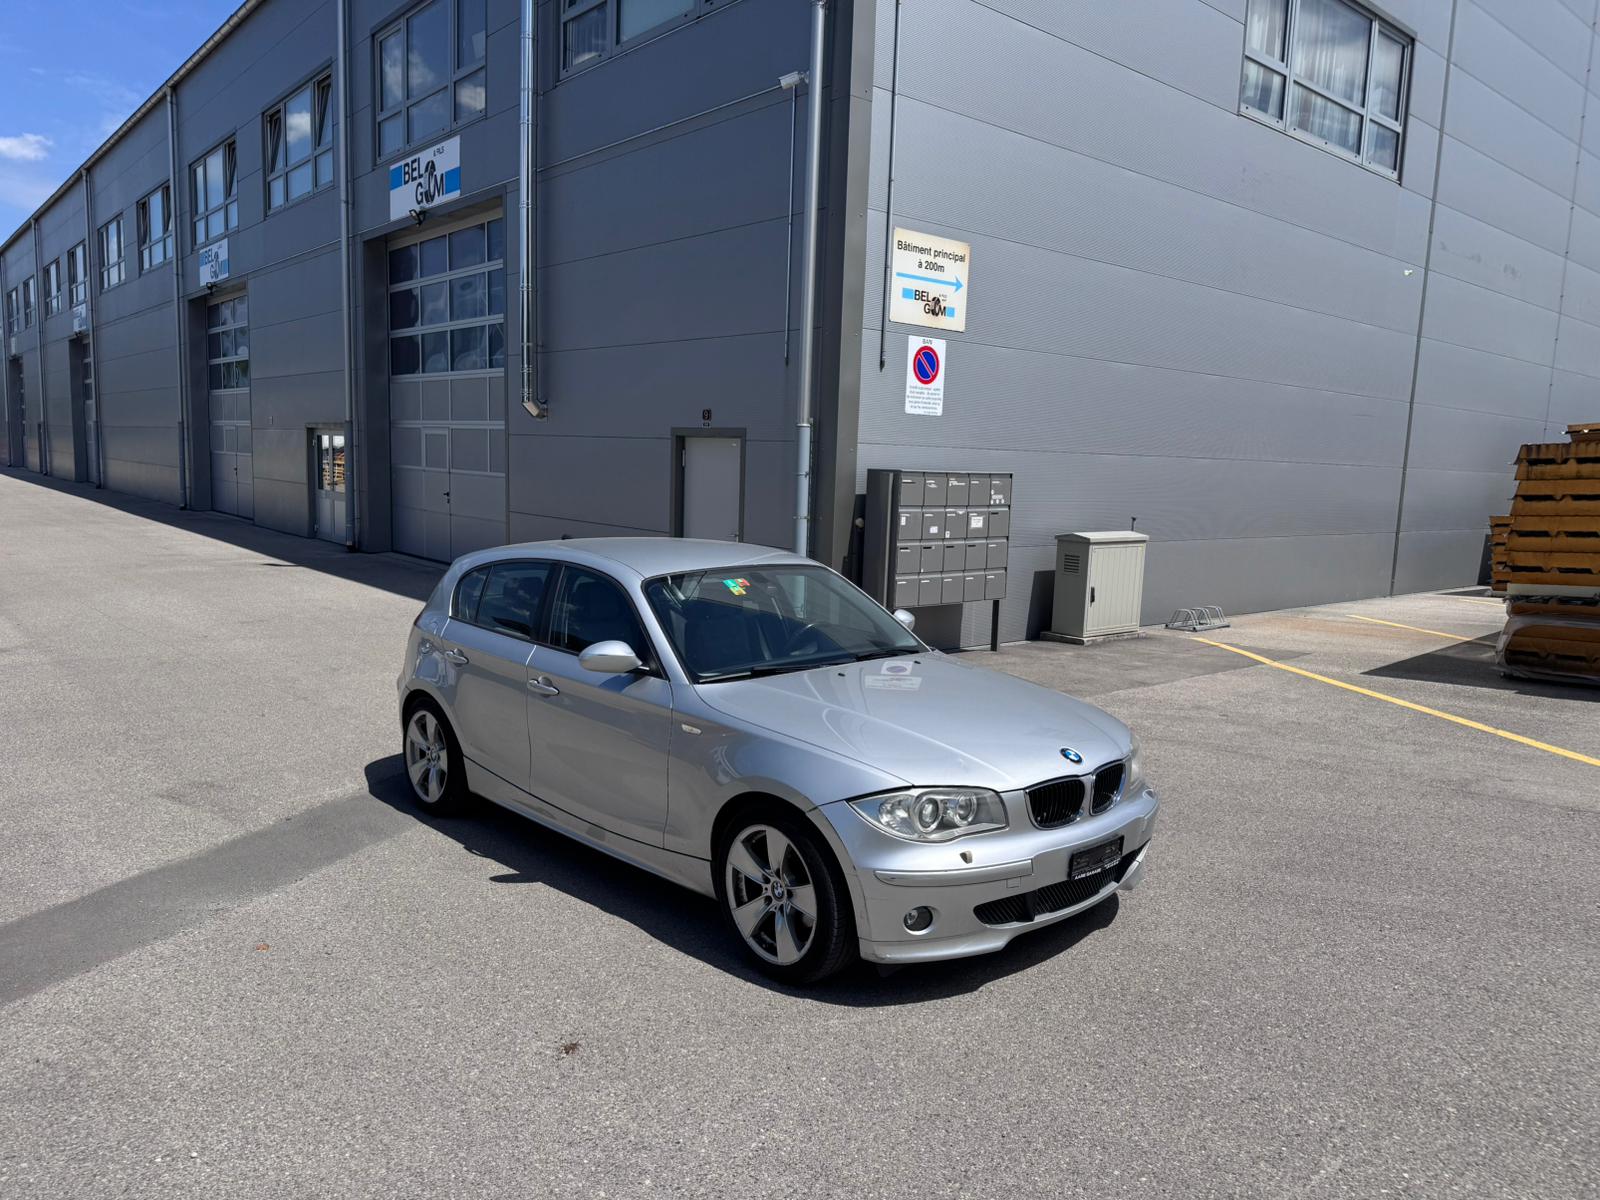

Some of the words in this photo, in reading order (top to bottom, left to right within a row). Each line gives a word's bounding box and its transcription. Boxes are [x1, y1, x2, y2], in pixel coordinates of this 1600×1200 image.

[403, 157, 424, 186] BEL
[897, 239, 932, 256] Bâtiment
[933, 249, 966, 264] principal
[917, 258, 923, 269] à
[924, 260, 945, 273] 200m
[914, 289, 932, 303] BEL
